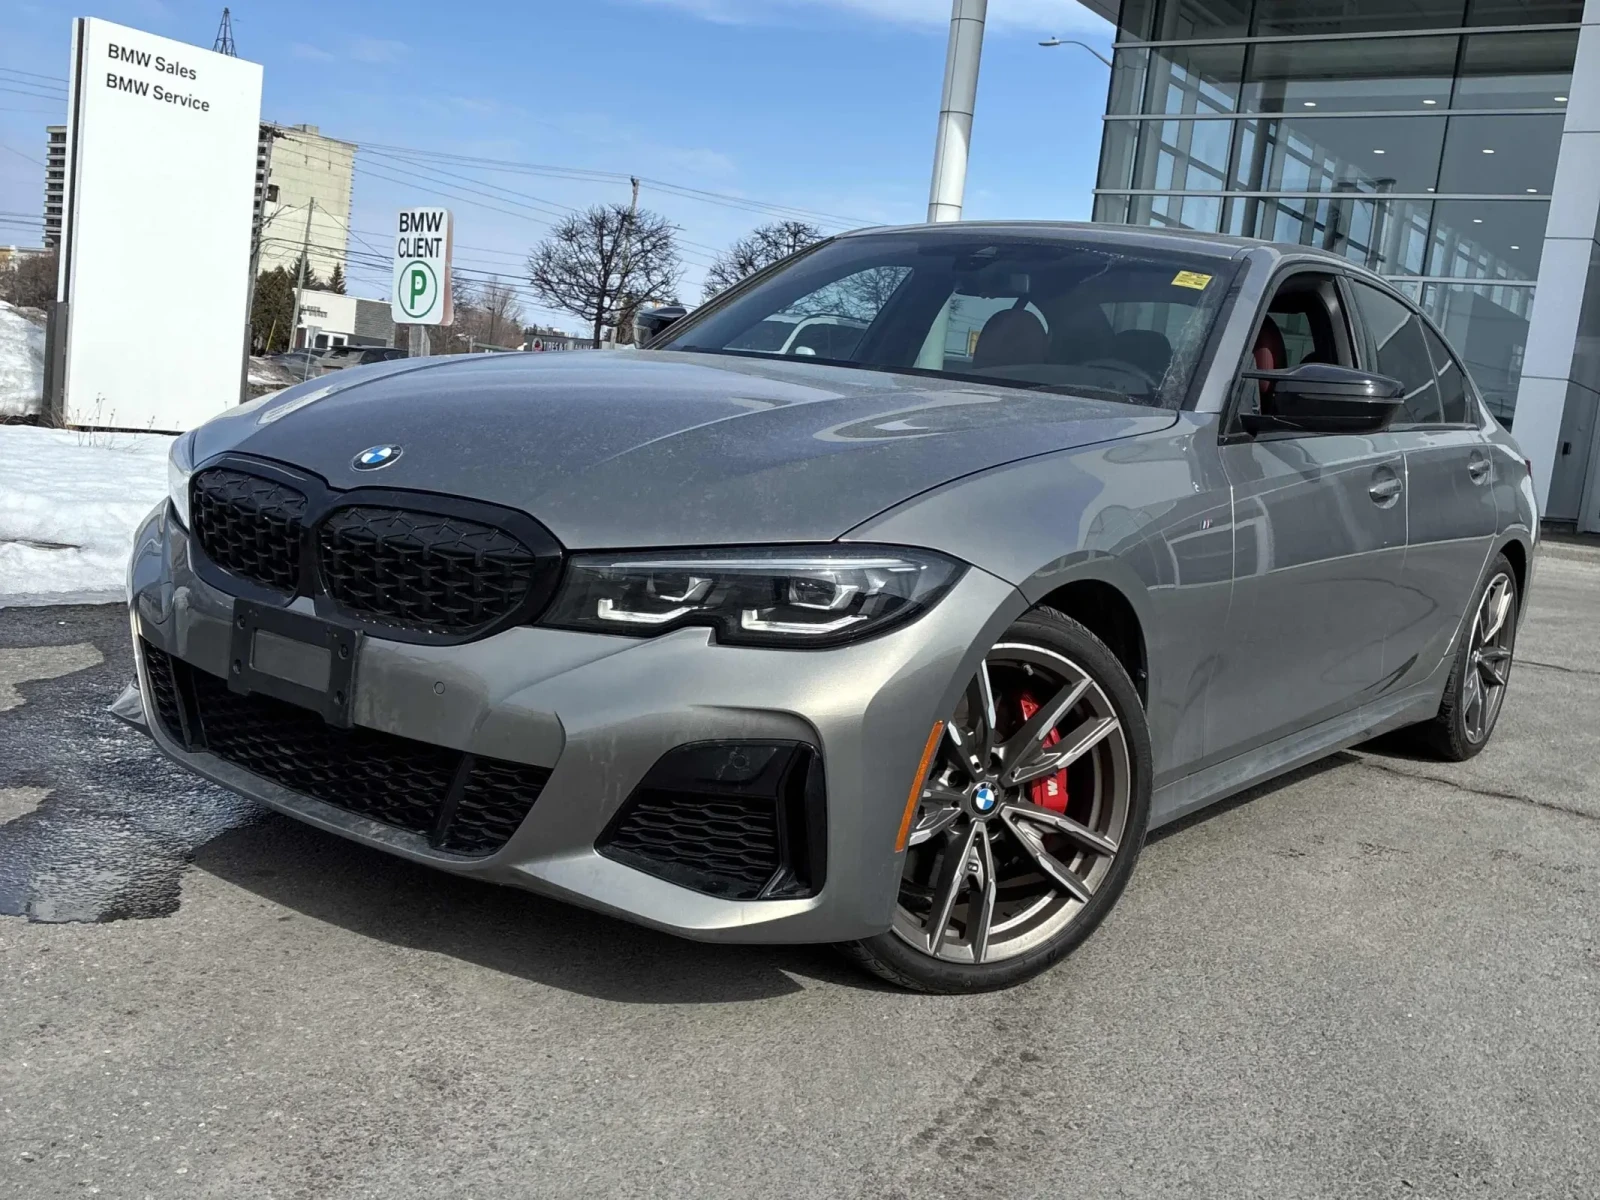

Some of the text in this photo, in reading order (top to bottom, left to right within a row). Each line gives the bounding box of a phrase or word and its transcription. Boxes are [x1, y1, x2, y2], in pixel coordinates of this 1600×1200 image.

[107, 43, 197, 81] BMW Sales
[106, 72, 210, 112] BMW Service
[399, 212, 444, 233] BMW
[397, 237, 442, 258] CLIENT
[409, 269, 427, 310] P
